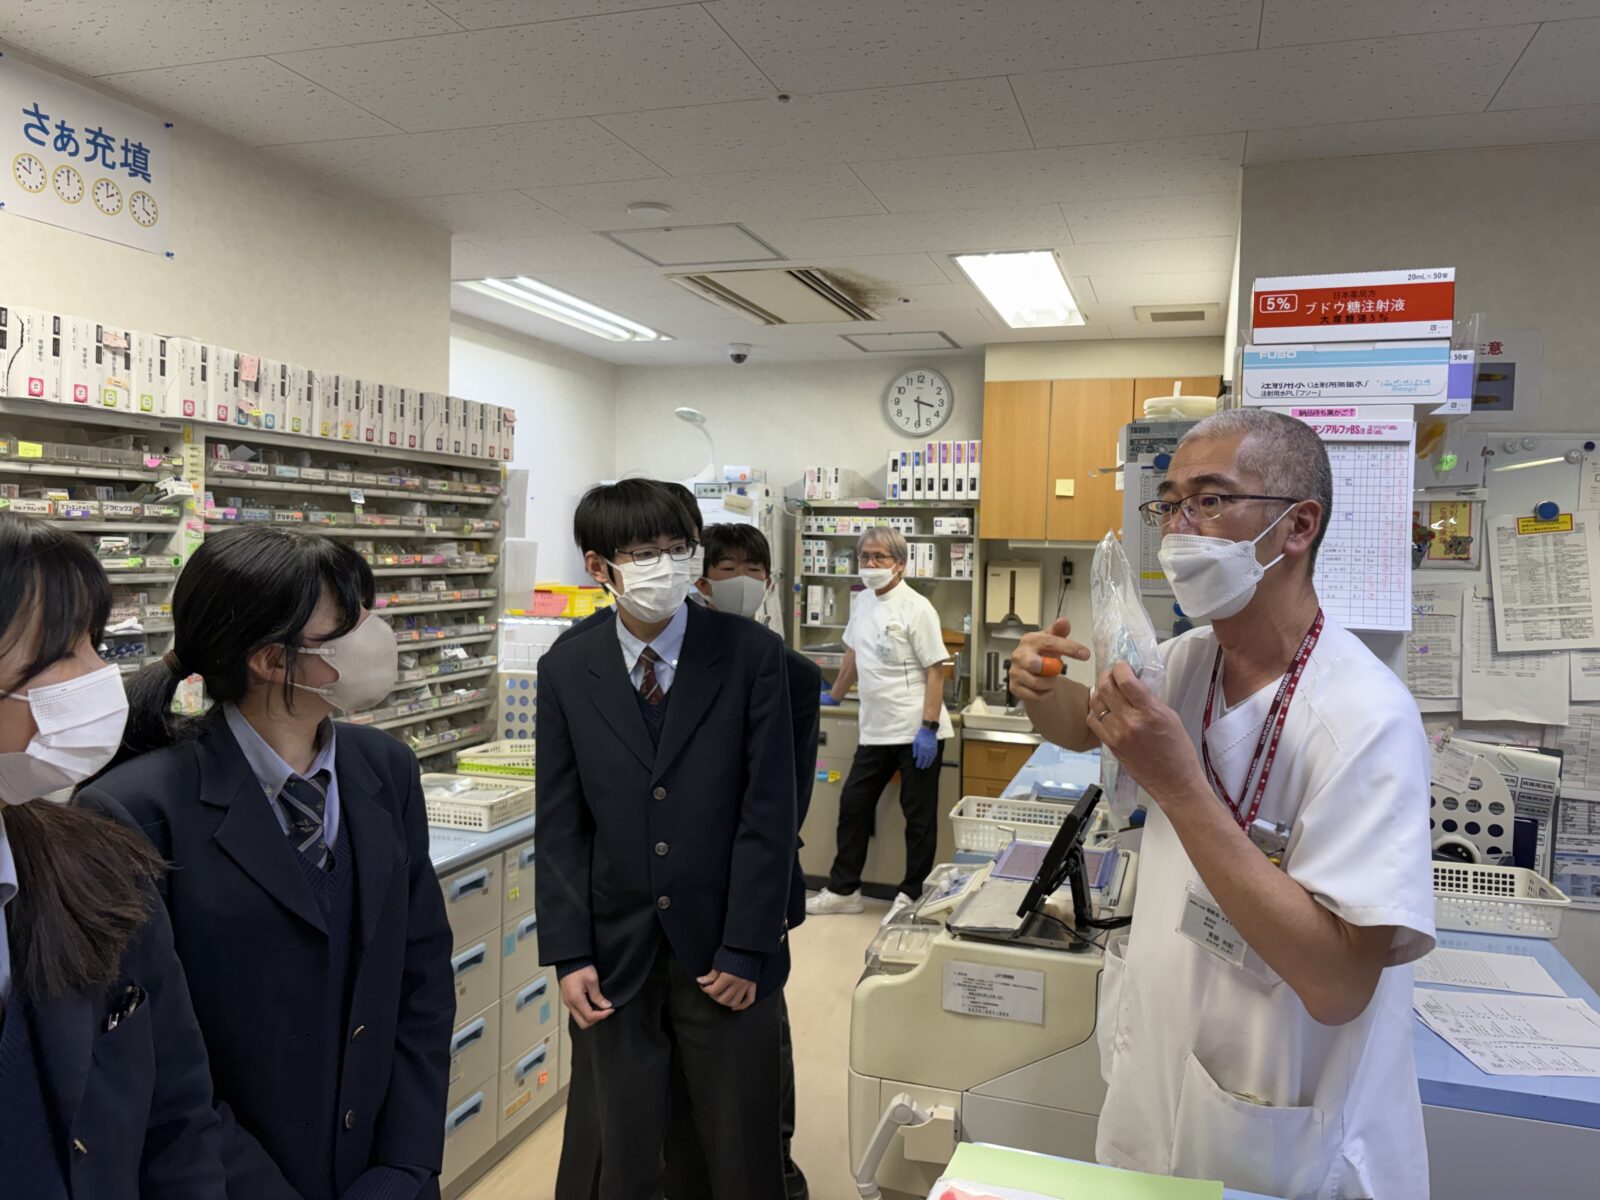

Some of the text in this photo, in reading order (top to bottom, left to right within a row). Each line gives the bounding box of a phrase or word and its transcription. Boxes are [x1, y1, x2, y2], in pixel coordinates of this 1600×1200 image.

[22, 102, 151, 184] さあ充填
[1266, 296, 1291, 311] 5%
[1305, 298, 1406, 315] ブドウ糖注射液
[906, 376, 913, 386] 11
[917, 375, 925, 383] 12
[931, 378, 934, 387] 1
[895, 386, 906, 395] 10
[936, 386, 942, 395] 2
[894, 397, 900, 406] 9
[938, 398, 944, 407] 3
[896, 409, 903, 417] 8
[934, 410, 940, 418] 4
[905, 417, 910, 425] 7
[925, 418, 932, 426] 5
